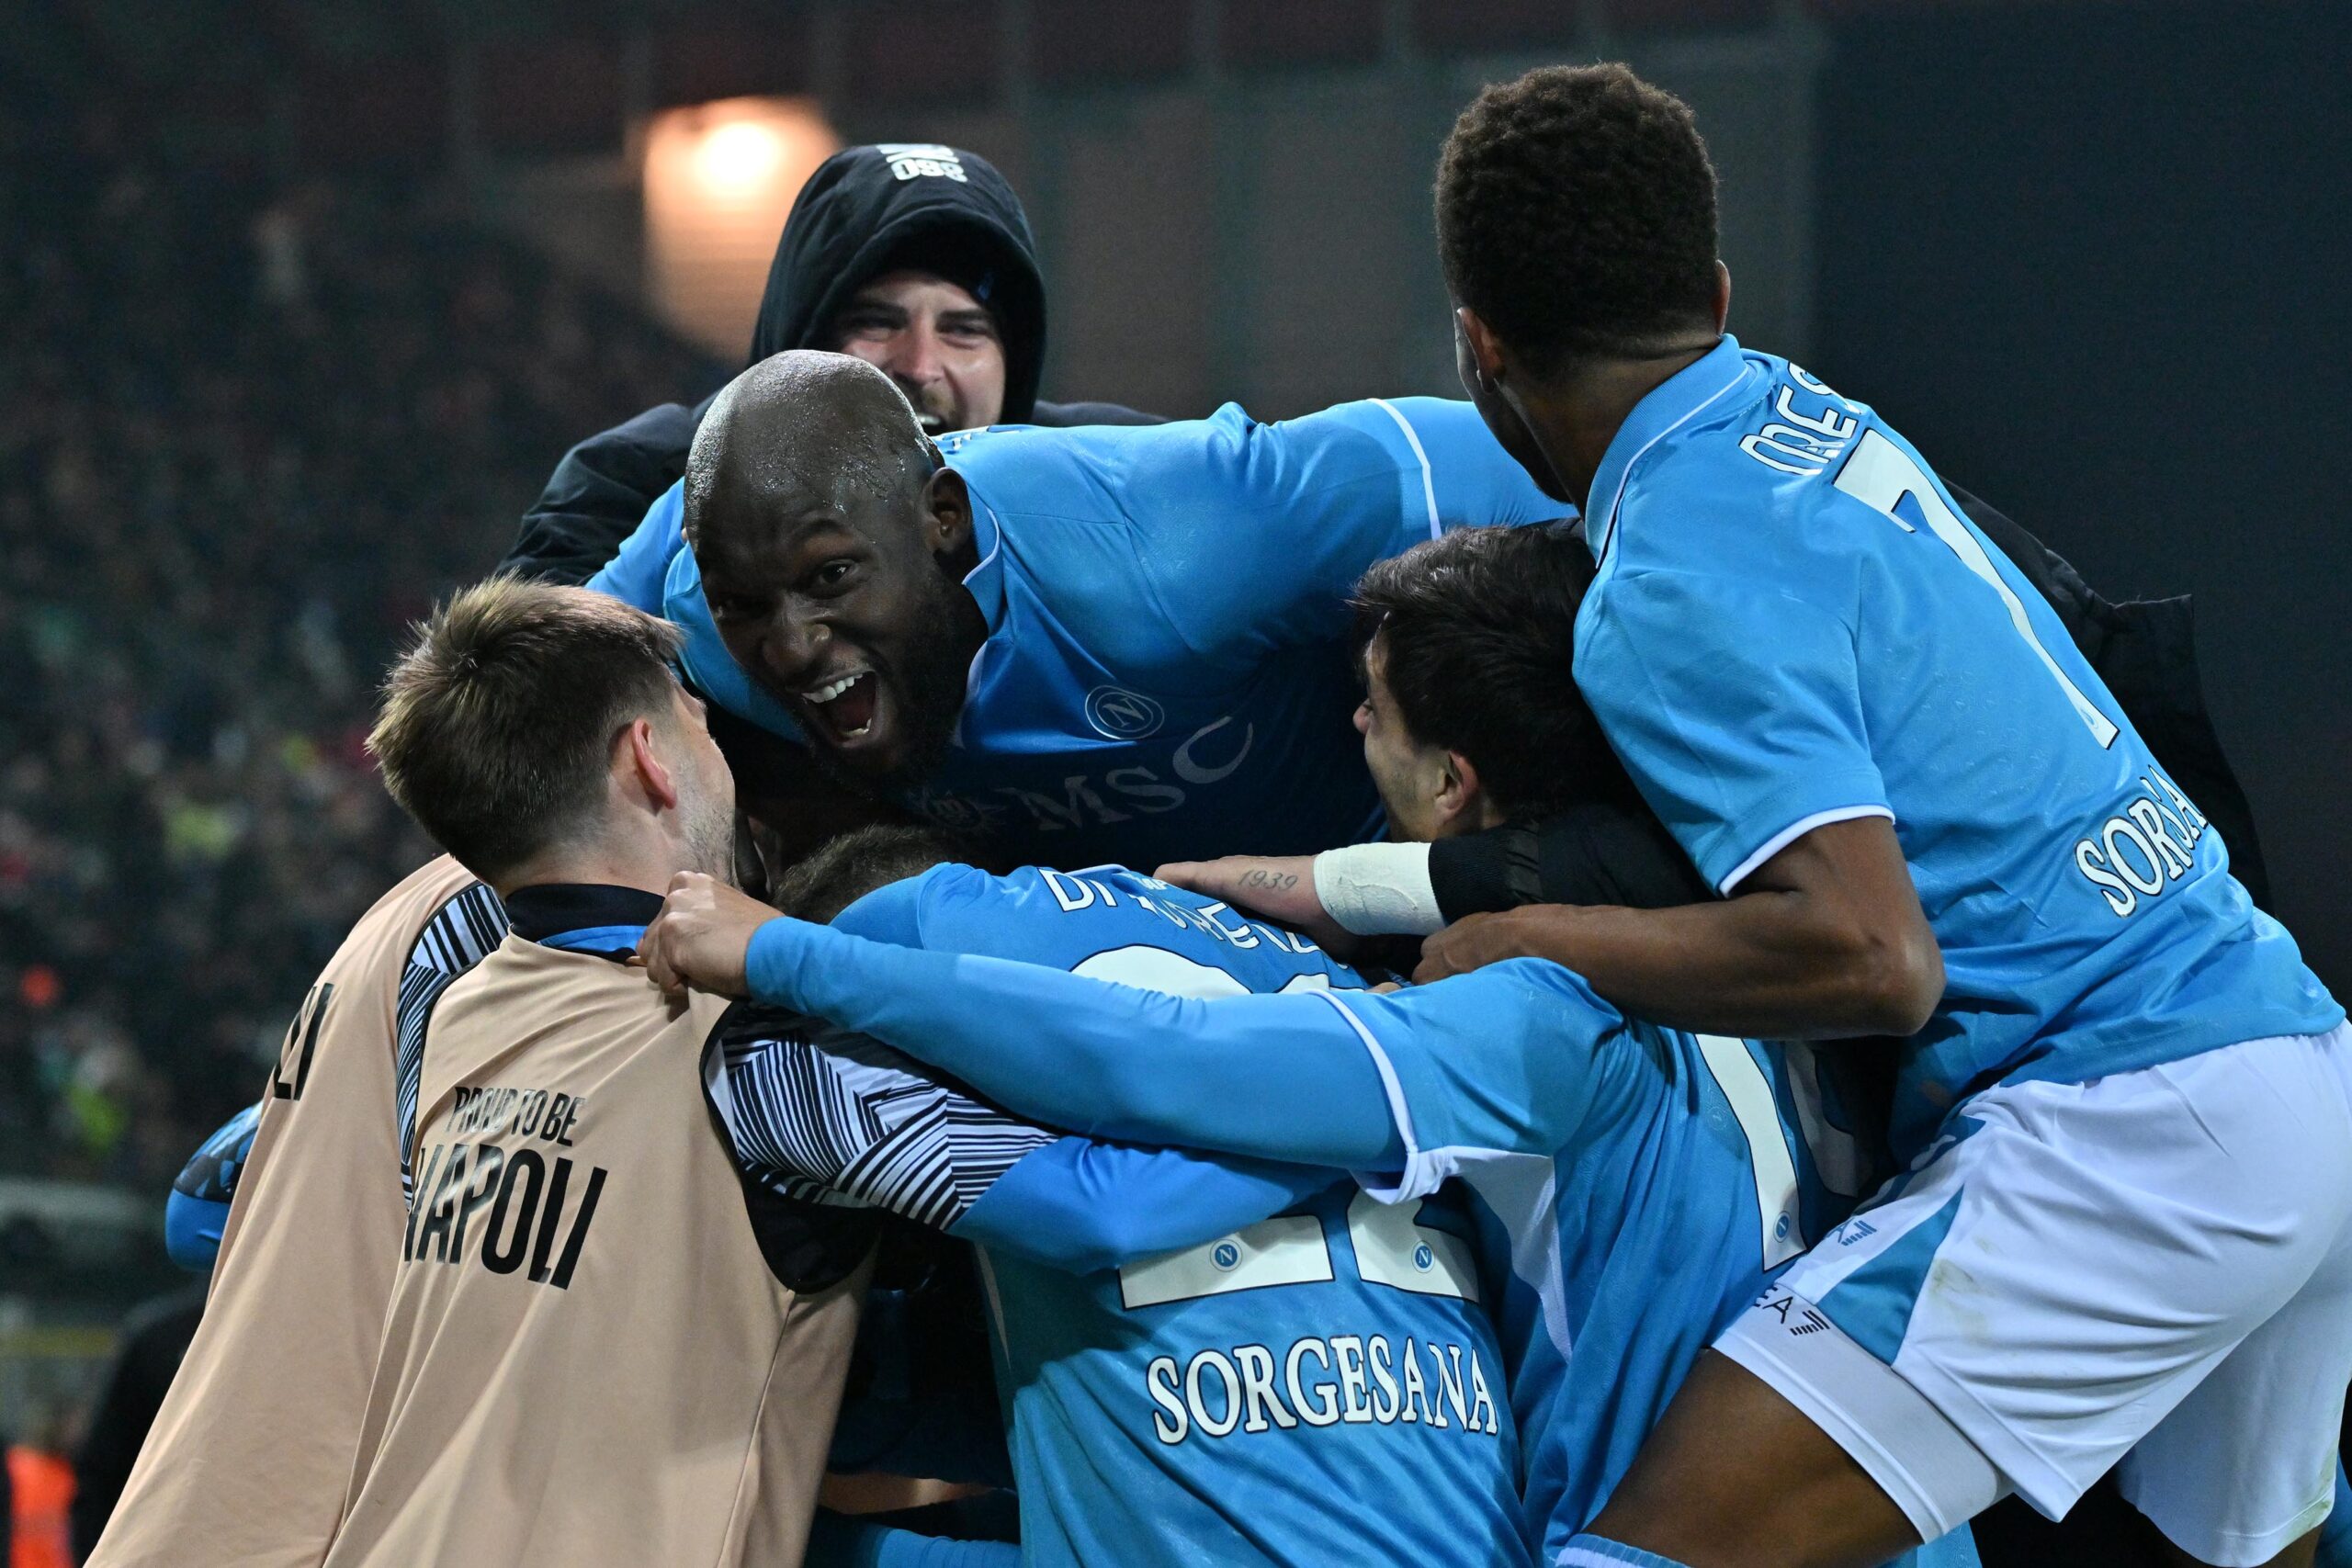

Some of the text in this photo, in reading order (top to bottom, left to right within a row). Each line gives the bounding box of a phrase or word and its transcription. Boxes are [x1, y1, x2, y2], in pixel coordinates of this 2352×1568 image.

[1833, 426, 2121, 750] 7
[991, 715, 1254, 831] MSC
[1037, 867, 1118, 913] DI
[1237, 869, 1298, 891] 1939
[511, 1089, 548, 1136] TO
[540, 1092, 586, 1146] BE
[1147, 1334, 1499, 1445] SORGESANA
